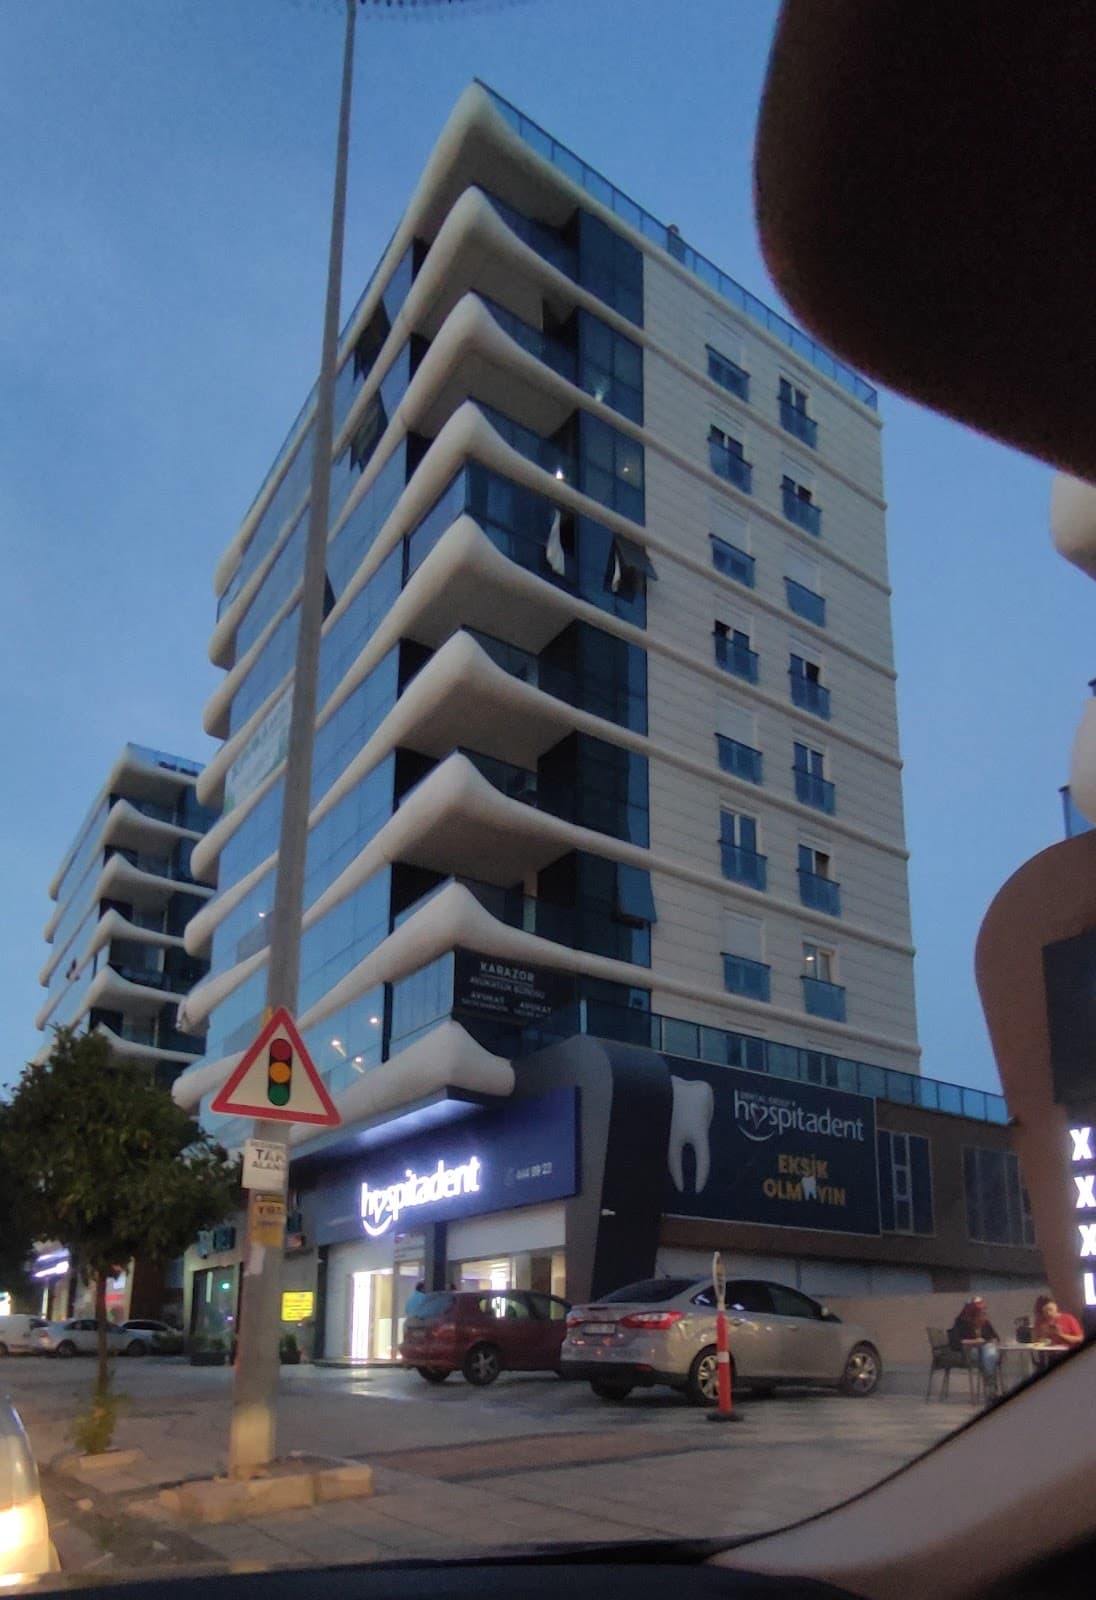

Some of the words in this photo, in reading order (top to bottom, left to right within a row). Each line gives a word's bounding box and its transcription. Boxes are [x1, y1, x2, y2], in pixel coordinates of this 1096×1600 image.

[734, 1089, 865, 1141] hospitadent
[361, 1156, 481, 1224] hospitadent
[777, 1153, 829, 1179] EKSİK
